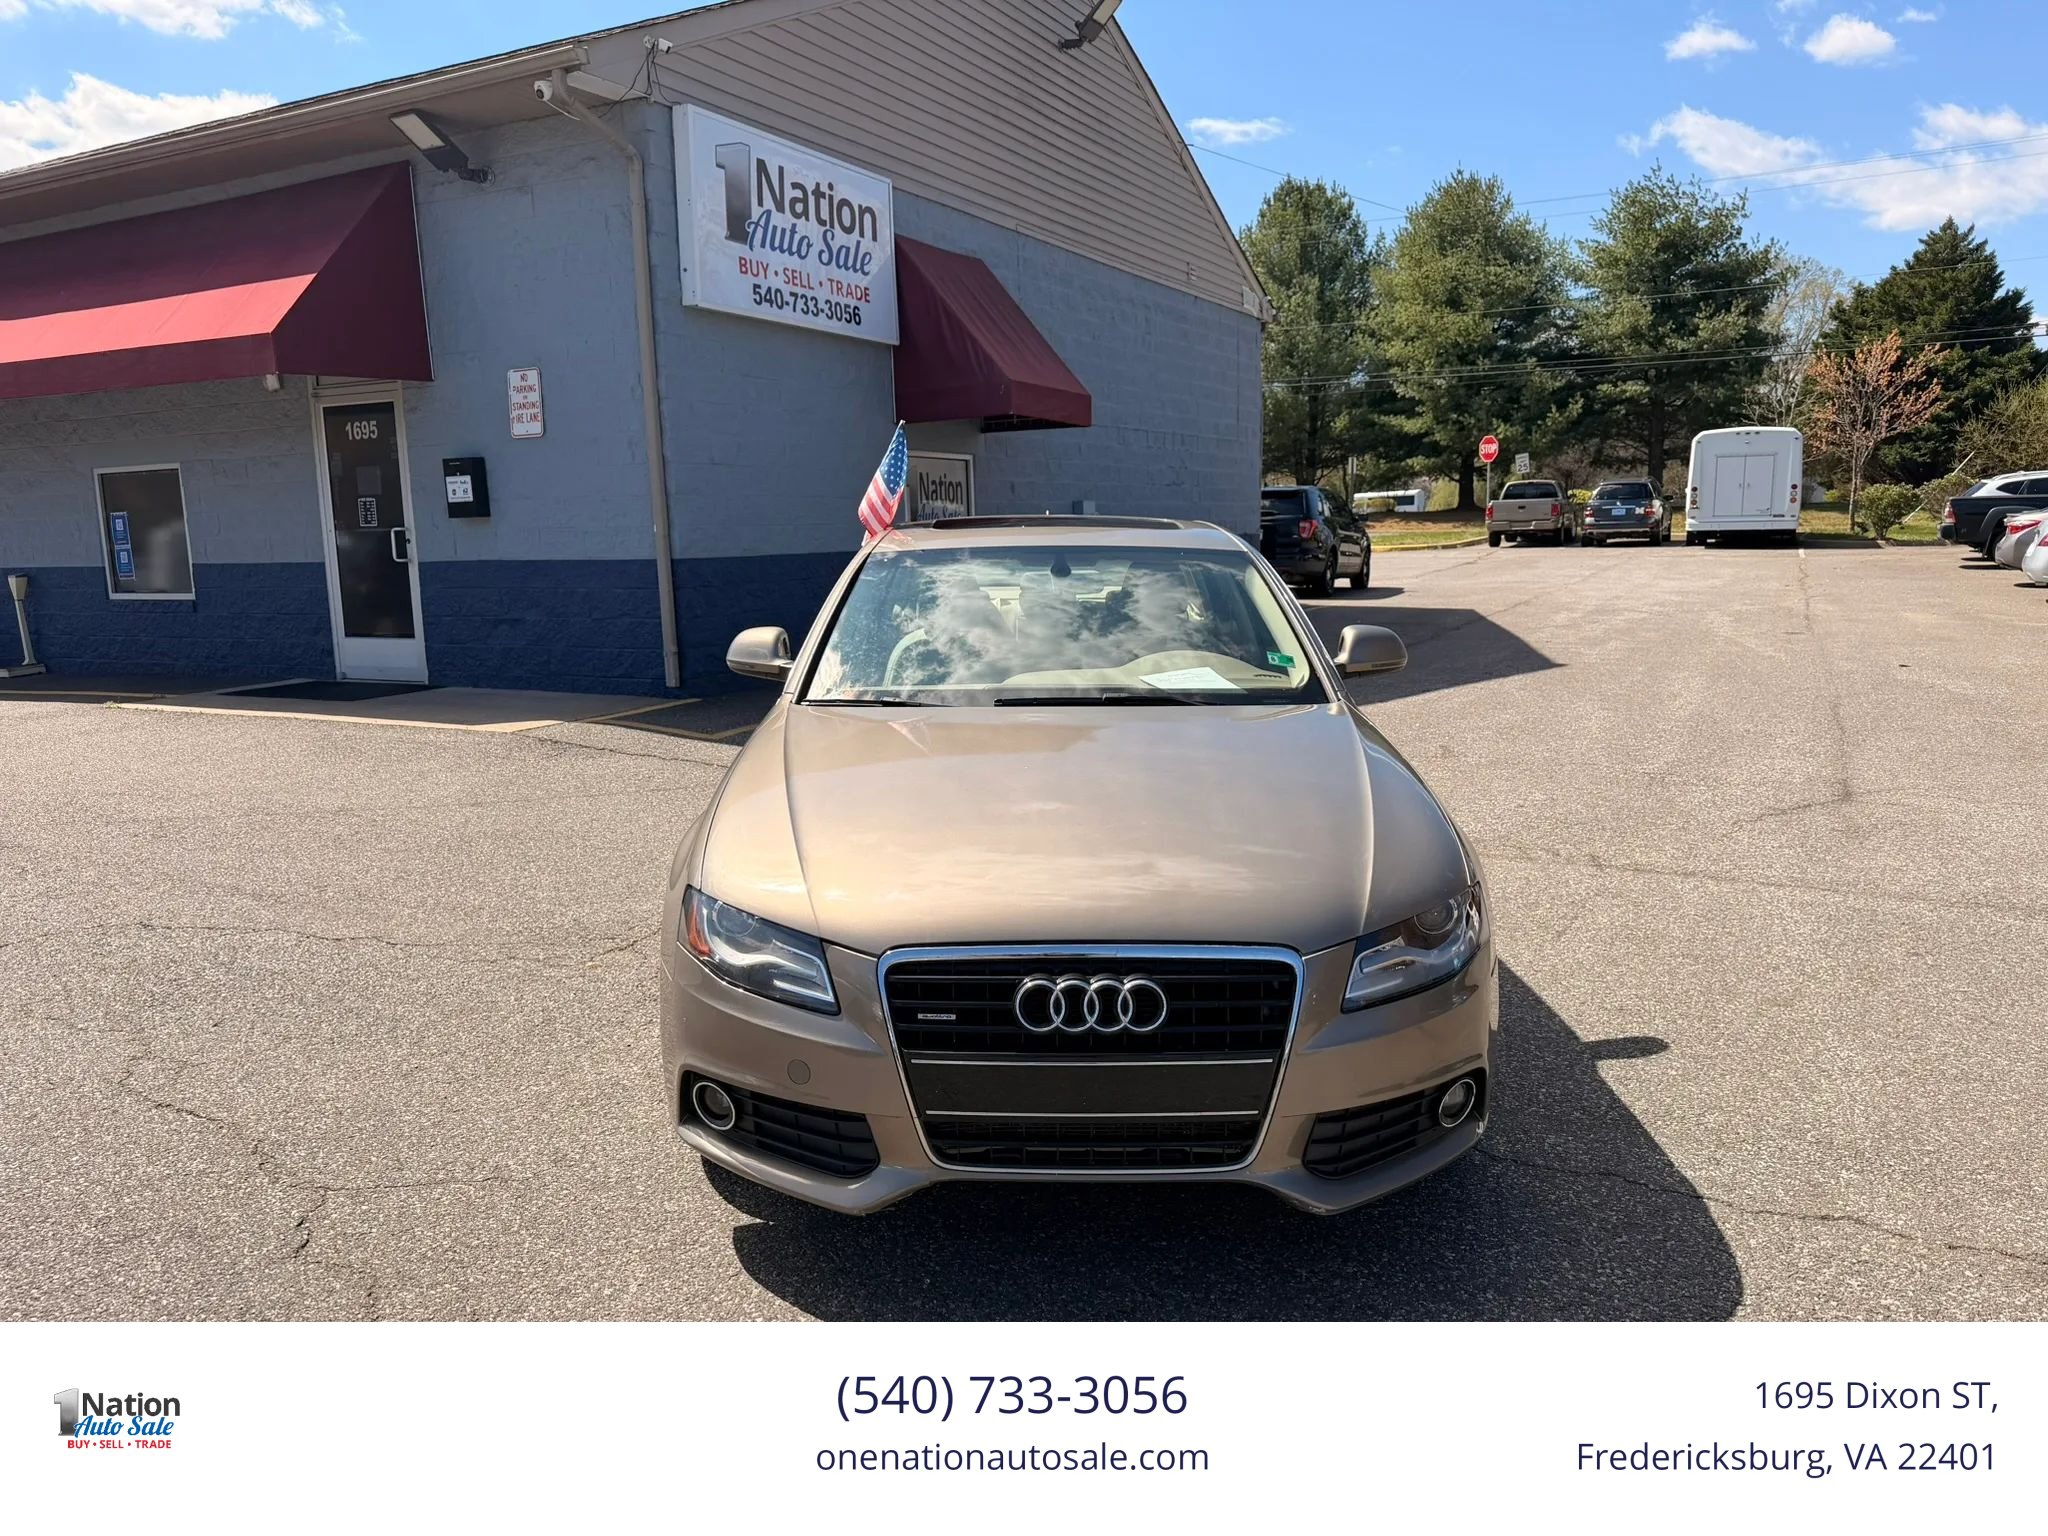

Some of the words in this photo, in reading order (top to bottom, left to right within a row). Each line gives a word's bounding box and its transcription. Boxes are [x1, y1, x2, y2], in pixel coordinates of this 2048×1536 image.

[745, 209, 813, 261] Auto
[818, 228, 872, 276] Sale
[738, 256, 770, 280] BUY
[783, 267, 815, 291] SELL
[827, 278, 871, 303] TRADE
[752, 283, 862, 326] 540-733-3056
[520, 373, 529, 383] NO
[512, 384, 537, 394] PARKING
[512, 401, 540, 411] STANDING
[526, 412, 541, 423] LANE
[345, 420, 378, 441] 1695
[1481, 443, 1497, 454] STOP
[1518, 463, 1528, 472] 25
[919, 472, 963, 504] Nation
